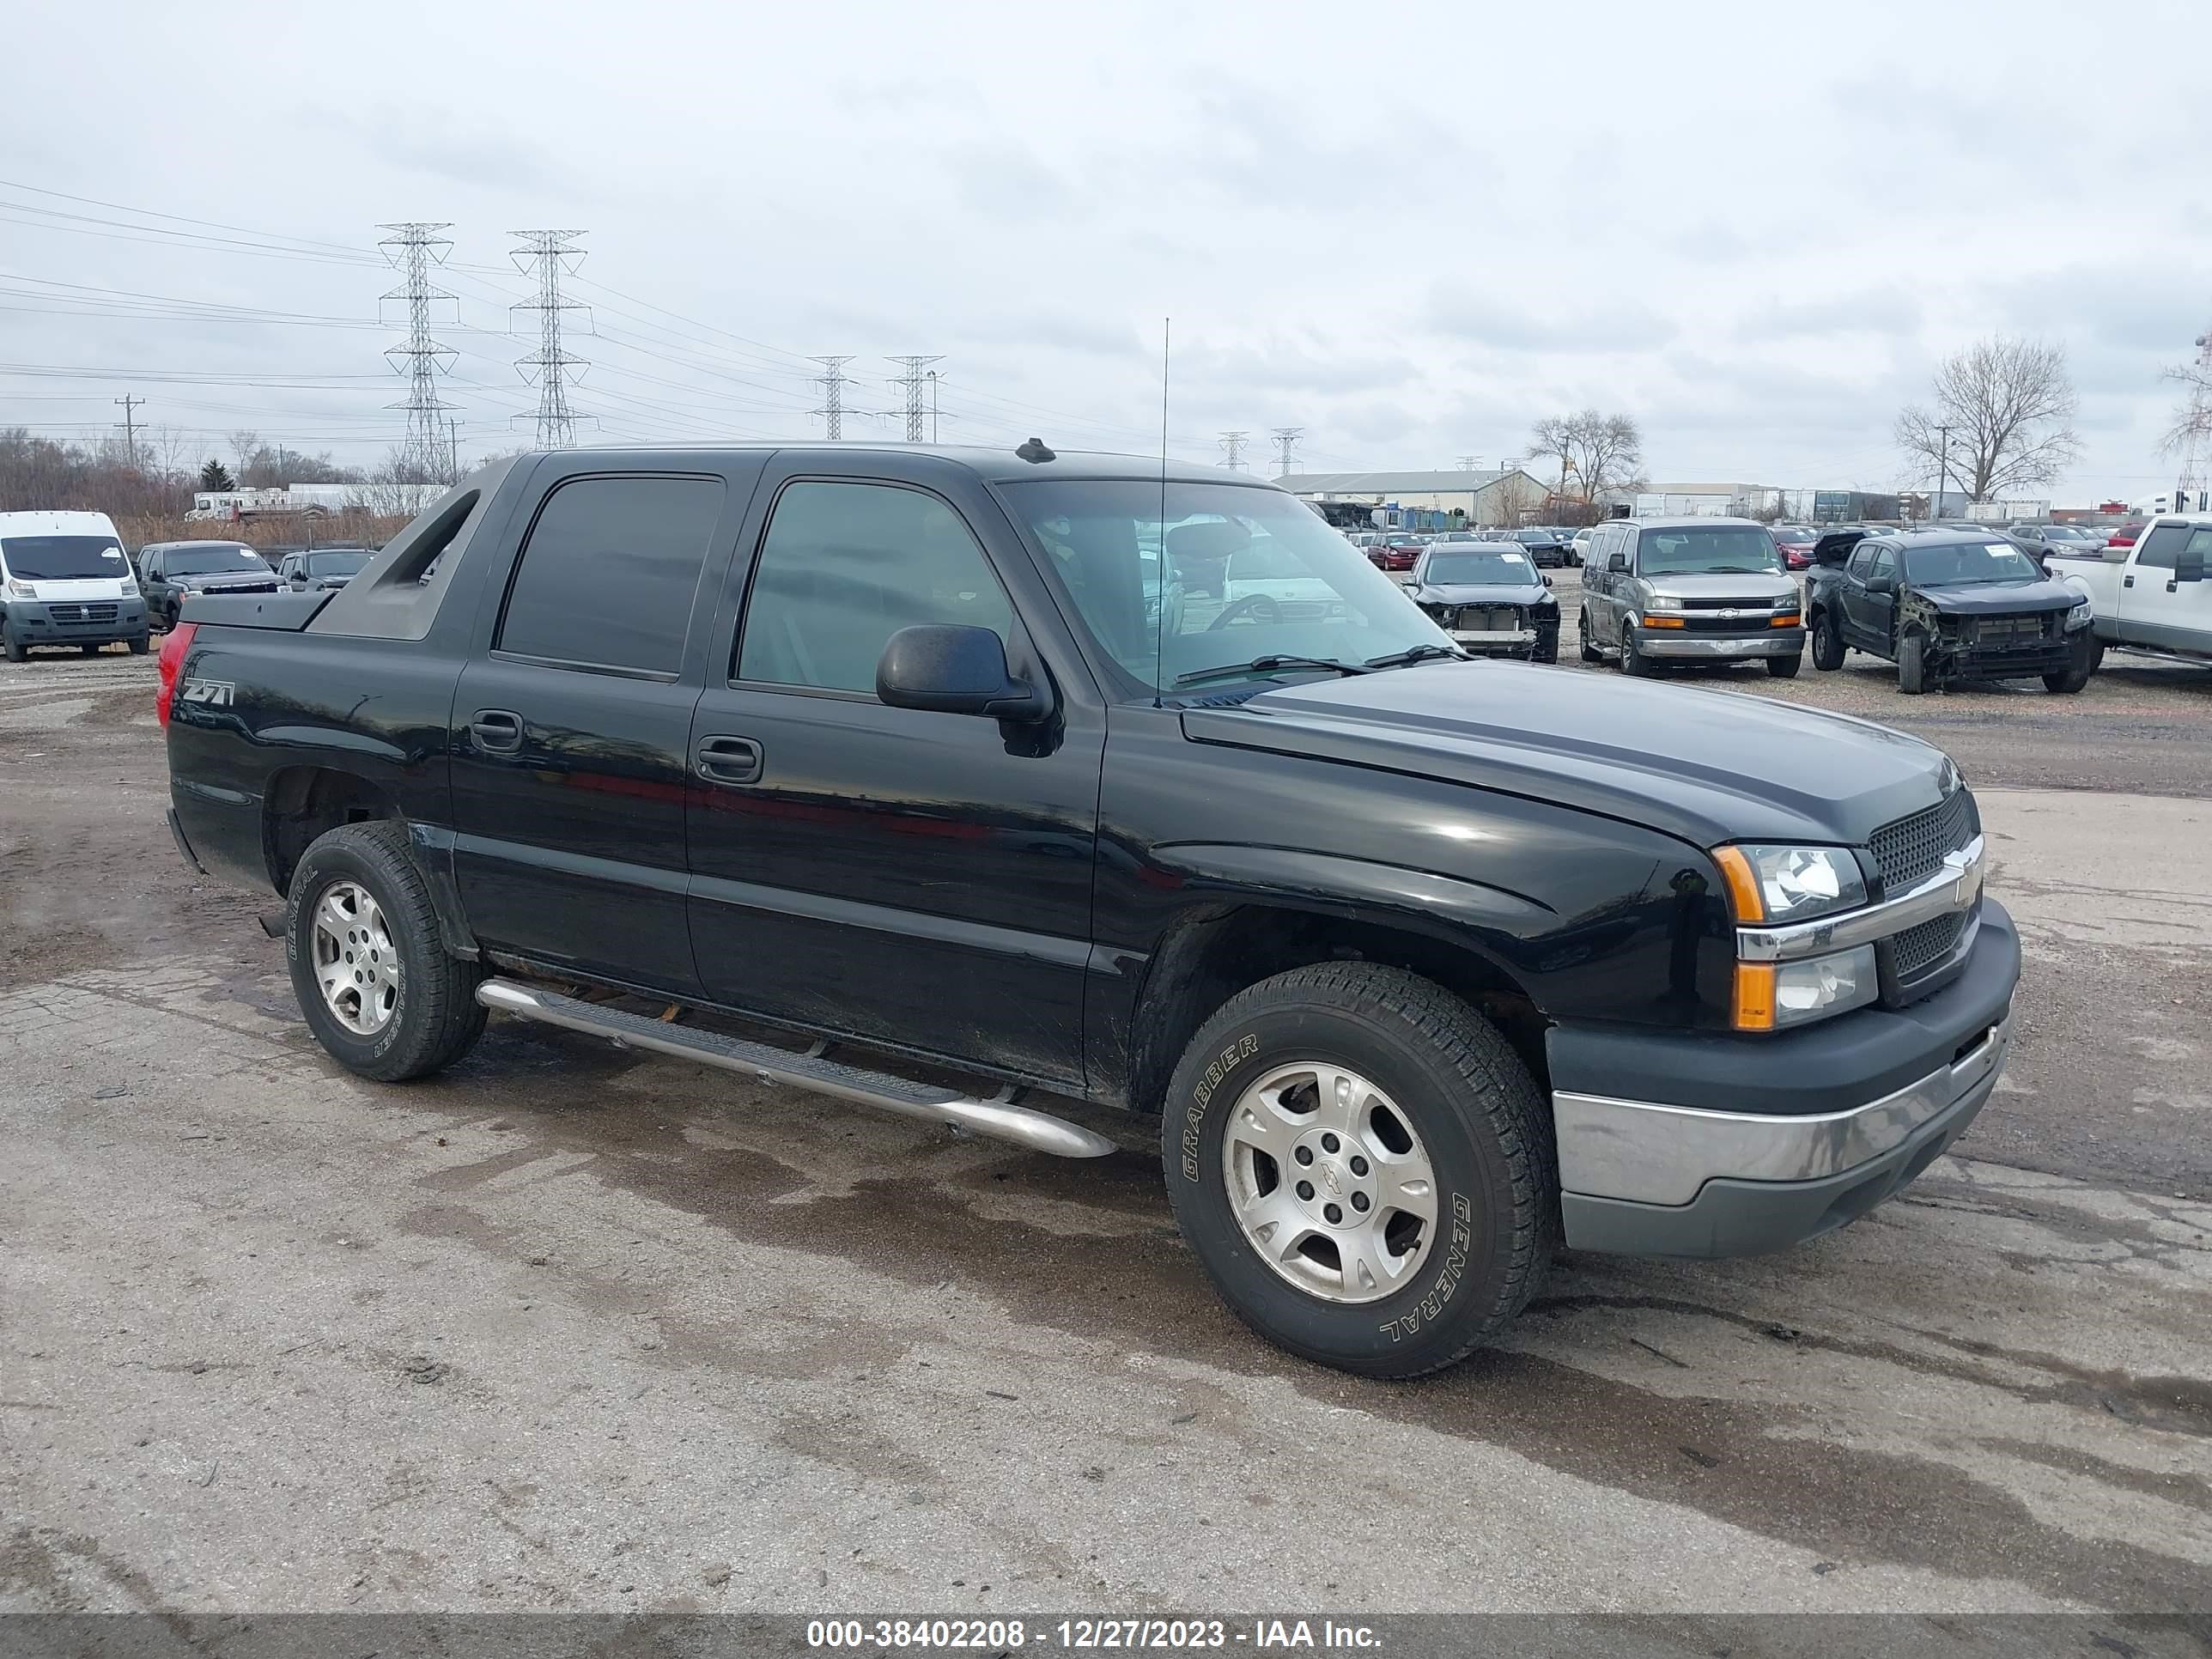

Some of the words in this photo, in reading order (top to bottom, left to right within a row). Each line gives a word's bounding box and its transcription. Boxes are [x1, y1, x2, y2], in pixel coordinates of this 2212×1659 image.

[183, 677, 234, 707] Z71
[288, 865, 318, 961] GENERAL
[374, 957, 406, 1058] GRABBER
[1182, 1033, 1259, 1182] GRABBER
[1379, 1192, 1471, 1342] GENERAL
